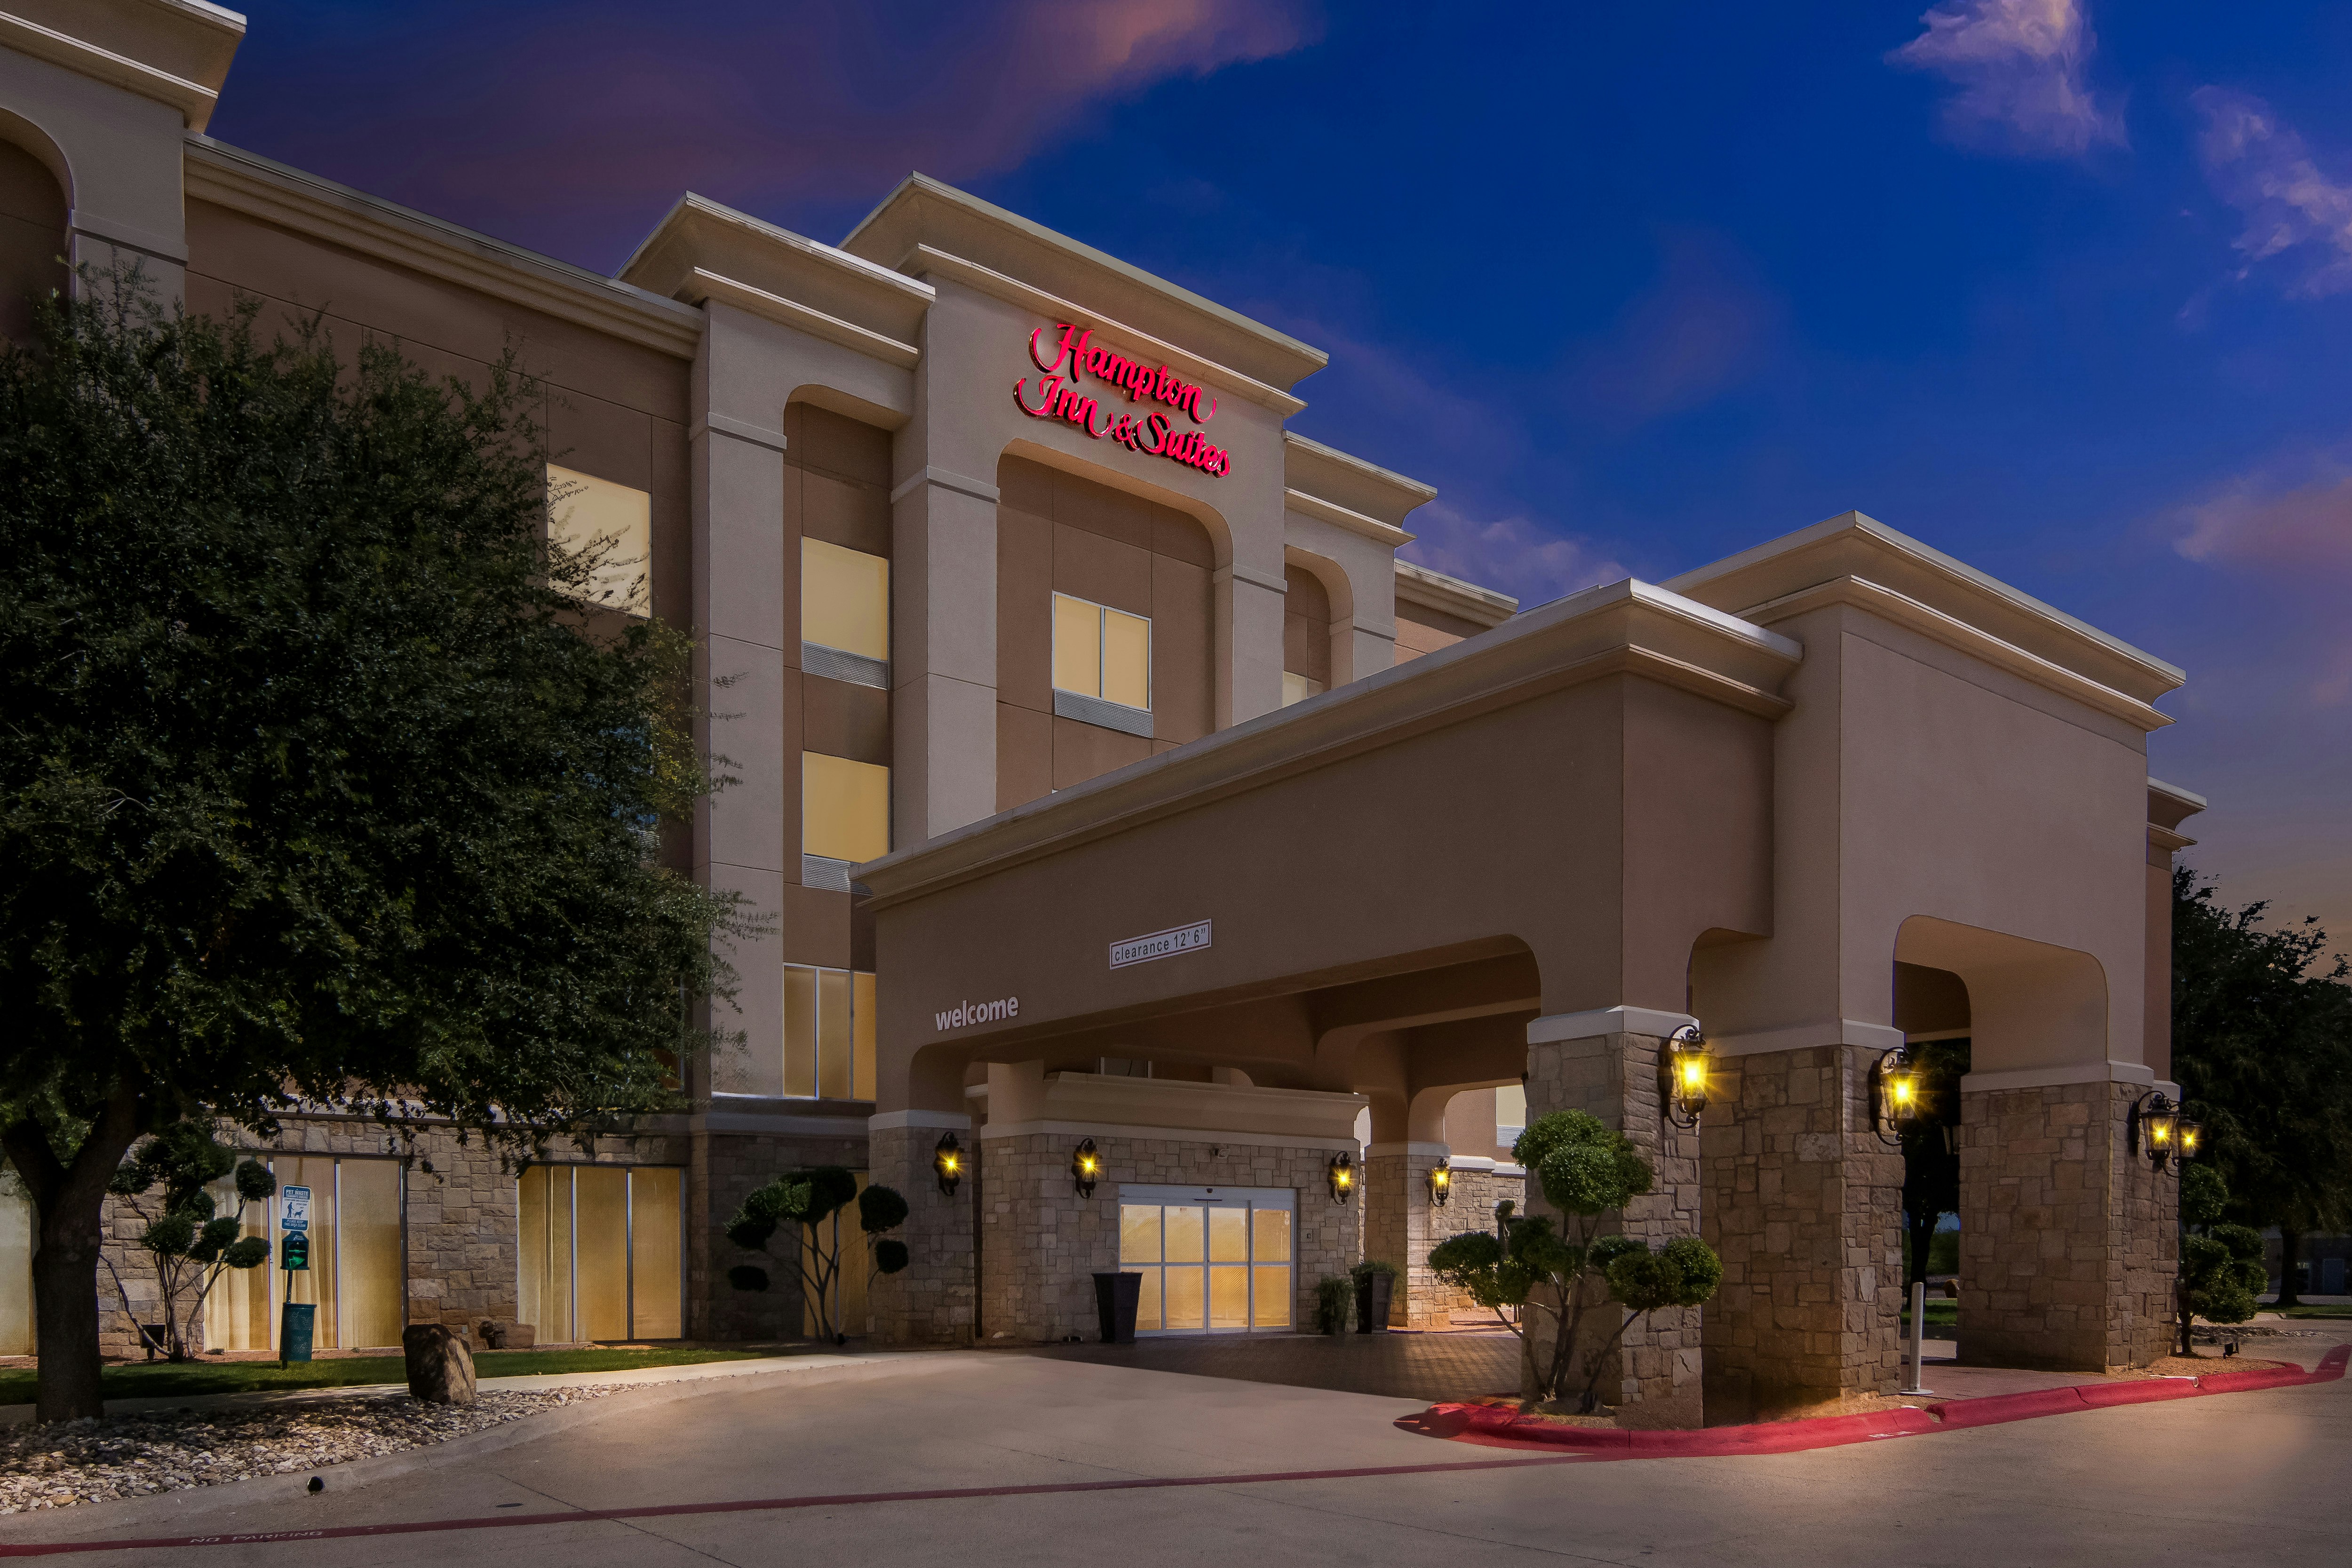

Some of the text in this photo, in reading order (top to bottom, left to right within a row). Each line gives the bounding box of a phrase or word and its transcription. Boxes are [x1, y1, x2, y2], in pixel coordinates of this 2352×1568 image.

[1028, 324, 1217, 424] Hampton
[1013, 375, 1231, 478] Inn & Suites
[1115, 939, 1169, 962] clearance
[935, 996, 1019, 1031] welcome
[232, 1531, 324, 1541] PARKING
